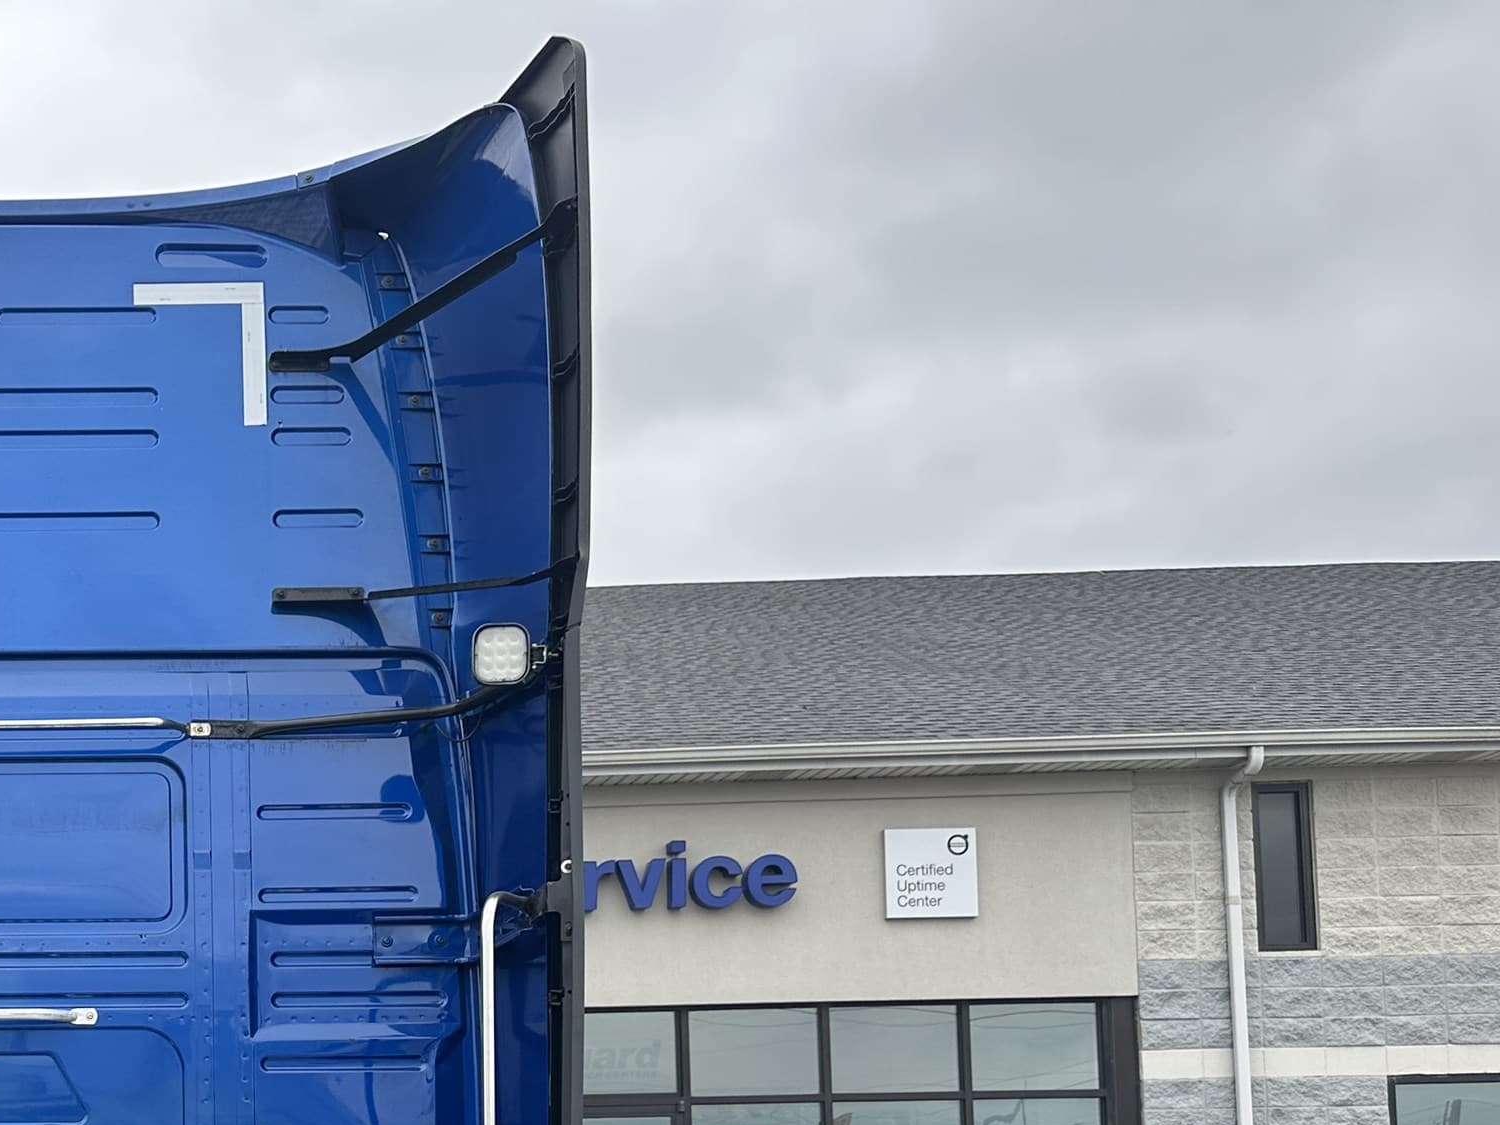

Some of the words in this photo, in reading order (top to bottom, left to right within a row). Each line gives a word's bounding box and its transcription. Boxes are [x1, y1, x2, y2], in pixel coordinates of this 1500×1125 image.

[896, 864, 954, 877] Certified
[897, 879, 946, 894] Uptime
[897, 895, 943, 908] Center
